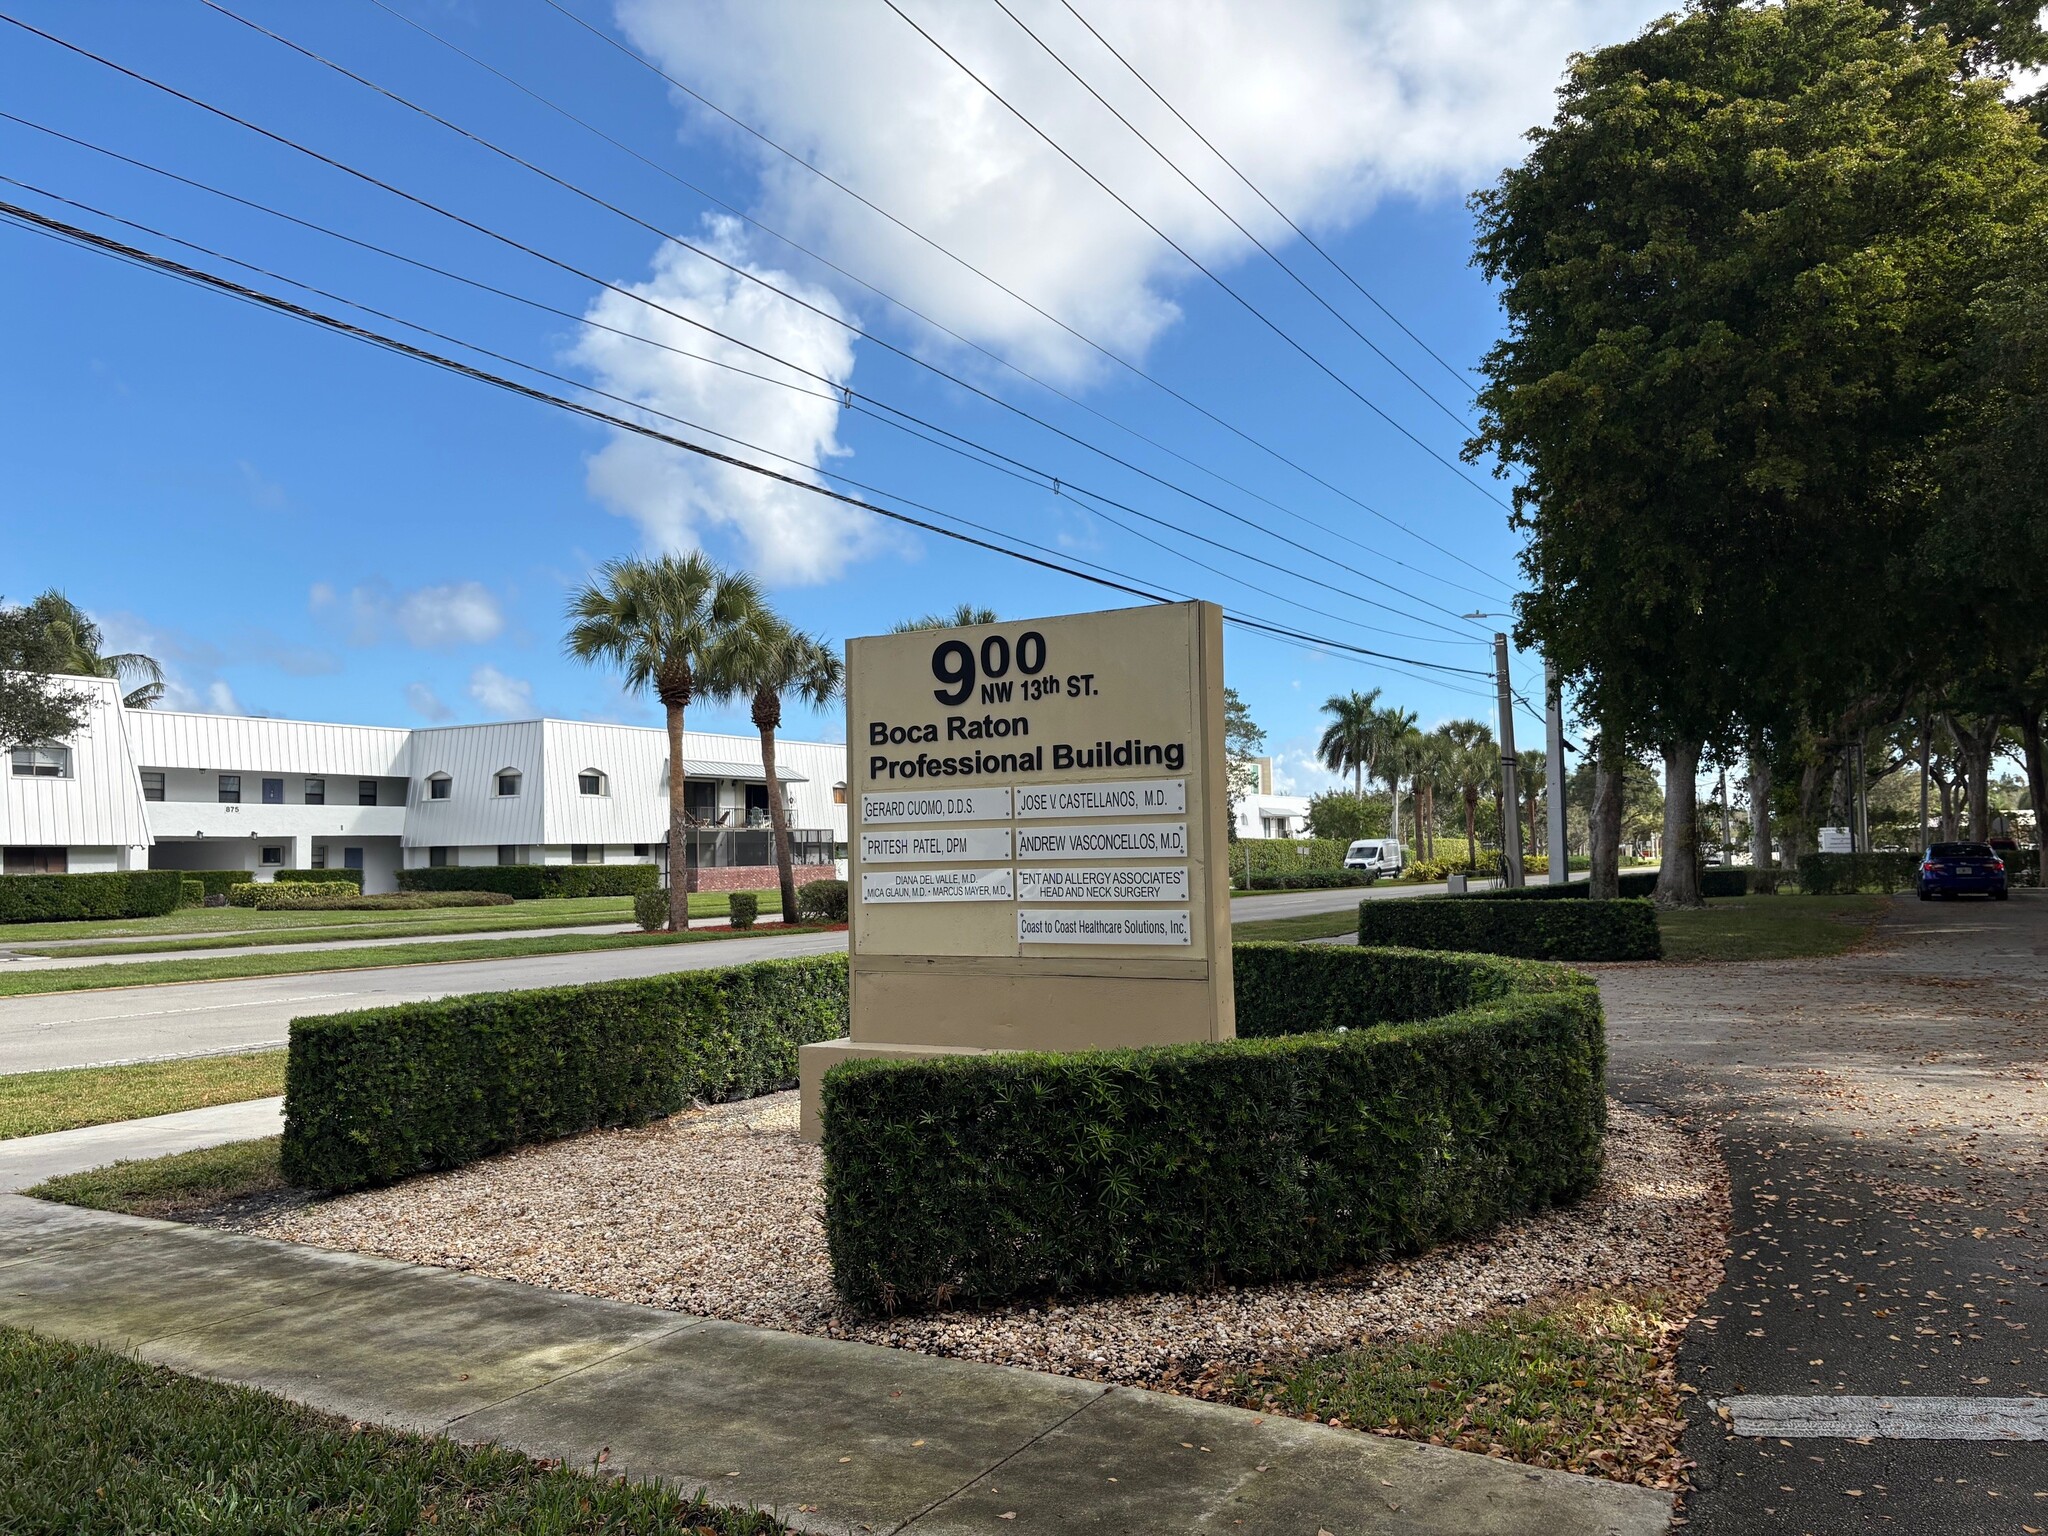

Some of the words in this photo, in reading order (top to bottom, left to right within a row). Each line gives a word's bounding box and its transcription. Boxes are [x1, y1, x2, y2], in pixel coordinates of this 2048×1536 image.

[931, 631, 1046, 706] 900
[981, 681, 1012, 704] NW
[1021, 675, 1059, 701] 13th
[1067, 674, 1098, 697] ST.
[870, 722, 937, 745] Boca
[947, 715, 1029, 740] Raton
[870, 746, 1042, 779] Professional
[1053, 740, 1184, 770] Building
[865, 802, 904, 817] GERARD
[908, 800, 945, 816] CUOMO,
[948, 798, 975, 814] D.D.S.
[1021, 794, 1047, 810] JOSE
[1059, 791, 1138, 809] CASTELLANOS,
[1145, 790, 1167, 806] M.D.
[868, 839, 908, 854] PRITESH
[913, 838, 943, 855] PATEL,
[947, 838, 967, 853] DPM
[1020, 836, 1065, 851] ANDREW
[1069, 833, 1158, 851] VASCONCELLOS,
[1161, 833, 1183, 849] M.D.
[896, 875, 918, 885] DIANA
[920, 875, 934, 884] DEL
[936, 875, 960, 884] VALLE,
[962, 874, 977, 883] M.D.
[1022, 873, 1042, 884] ENT
[1042, 873, 1063, 884] AND
[1065, 872, 1111, 884] ALLERGY
[1113, 872, 1180, 884] ASSOCIATES
[886, 887, 910, 898] GLAUN,
[912, 887, 926, 897] M.D.
[933, 886, 963, 896] MARCUS
[965, 886, 991, 896] MAYER,
[993, 885, 1007, 895] M.D.
[1040, 887, 1064, 897] HEAD
[1066, 887, 1084, 897] AND
[1087, 887, 1112, 897] NECK
[1114, 887, 1160, 897] SURGERY
[1021, 920, 1042, 933] Coast
[1045, 921, 1052, 933] to
[1055, 920, 1077, 933] Coast
[1079, 920, 1121, 933] Healthcare
[1125, 920, 1167, 935] Solutions,
[1171, 921, 1186, 934] Inc.
